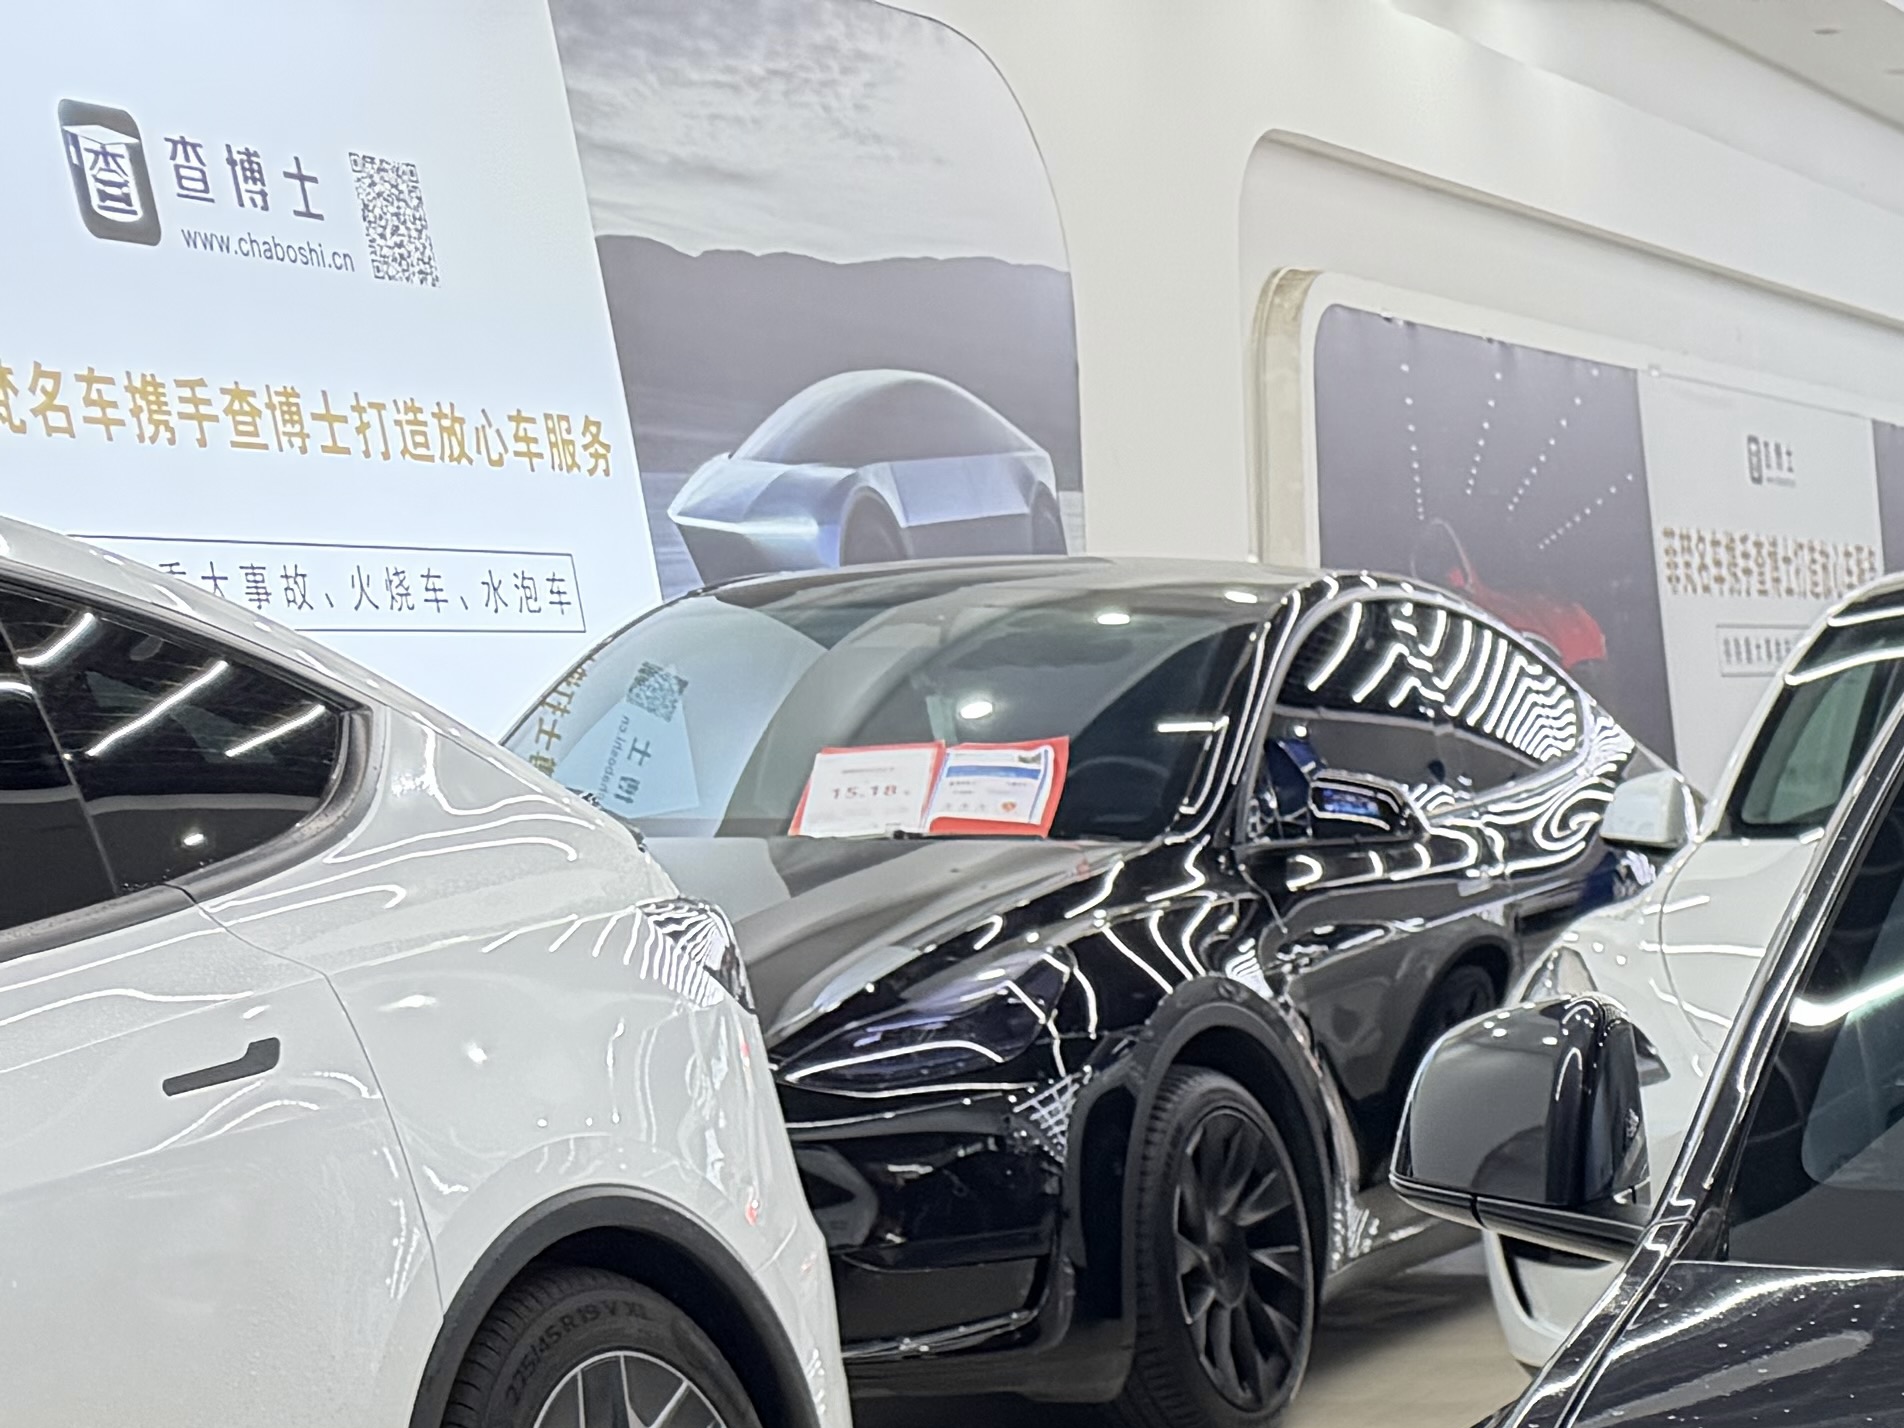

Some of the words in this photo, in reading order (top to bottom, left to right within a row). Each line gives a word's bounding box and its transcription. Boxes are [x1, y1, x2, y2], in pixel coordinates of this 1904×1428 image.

[163, 134, 325, 222] 查博士
[180, 227, 356, 273] www.chaboshi.cn
[158, 561, 572, 616] 大事故、火烧车、水泡车
[832, 785, 897, 800] 15.18
